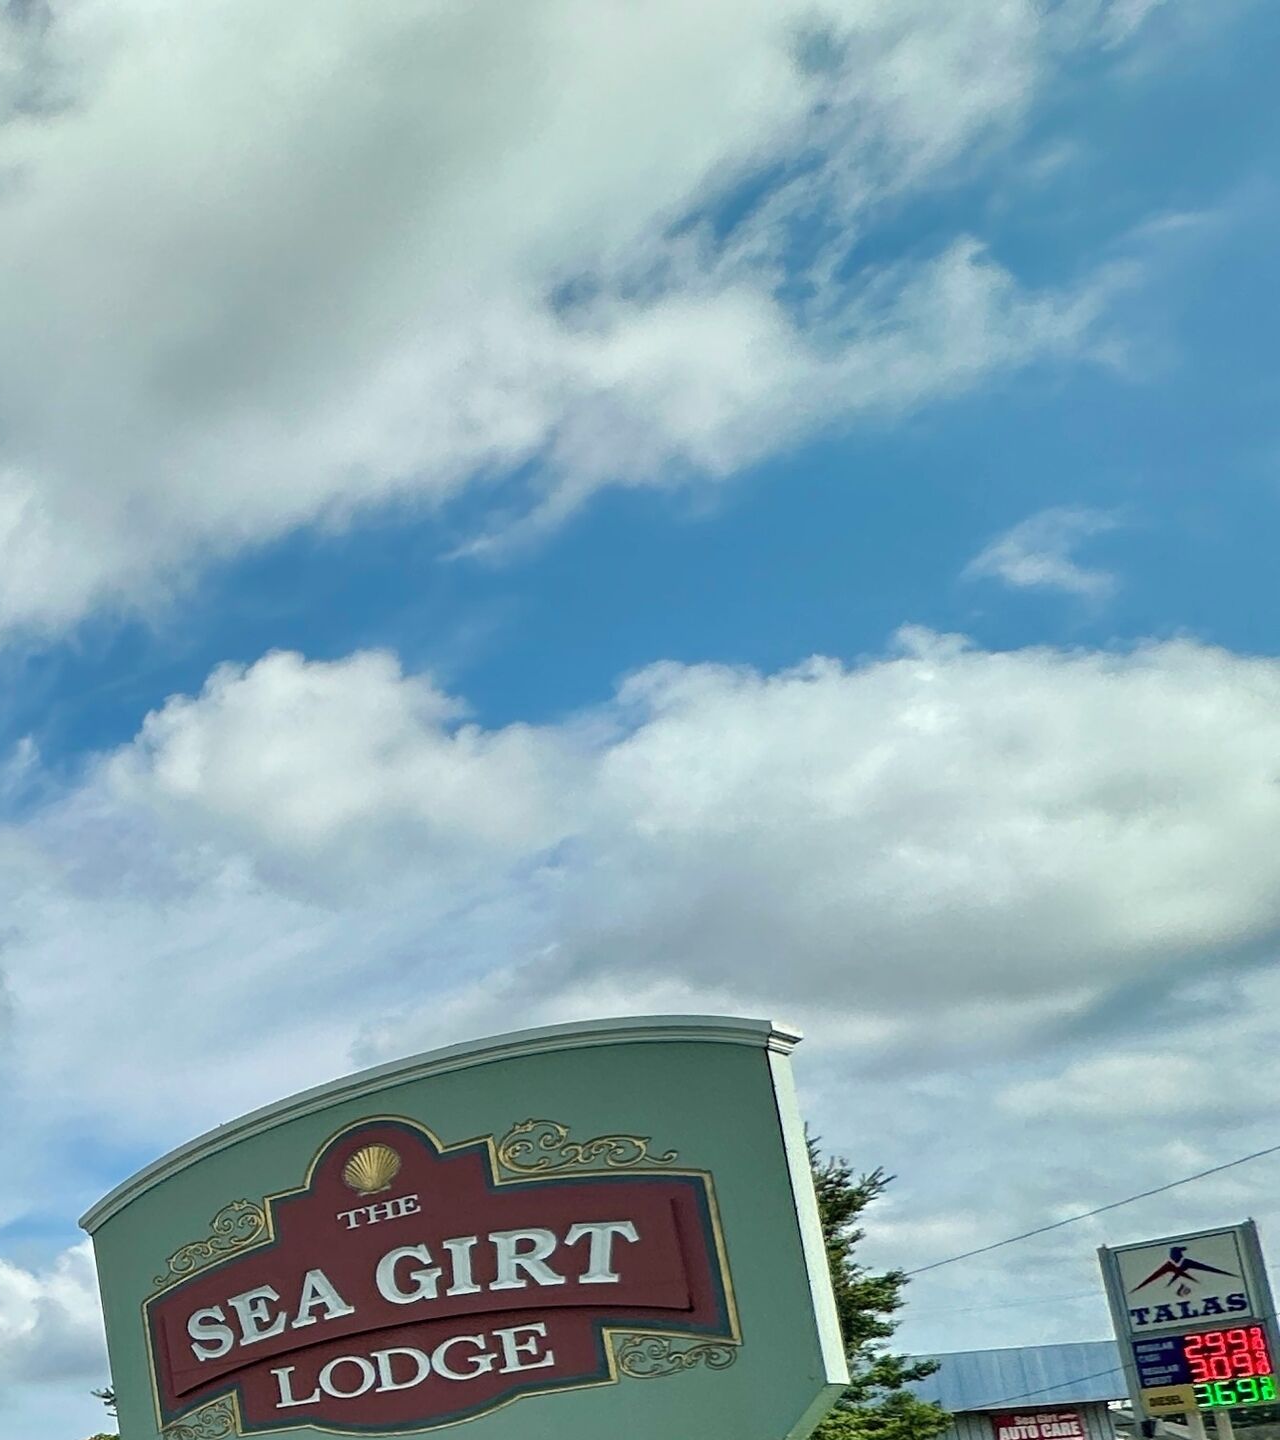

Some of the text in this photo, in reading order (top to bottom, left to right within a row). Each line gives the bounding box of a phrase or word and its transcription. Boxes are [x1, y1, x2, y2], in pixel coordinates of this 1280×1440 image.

[336, 1194, 422, 1230] THE
[186, 1220, 640, 1362] SEA GIRT
[1130, 1293, 1248, 1325] TALAS
[270, 1322, 555, 1409] LODGE
[999, 1421, 1081, 1440] AUTO CARE
